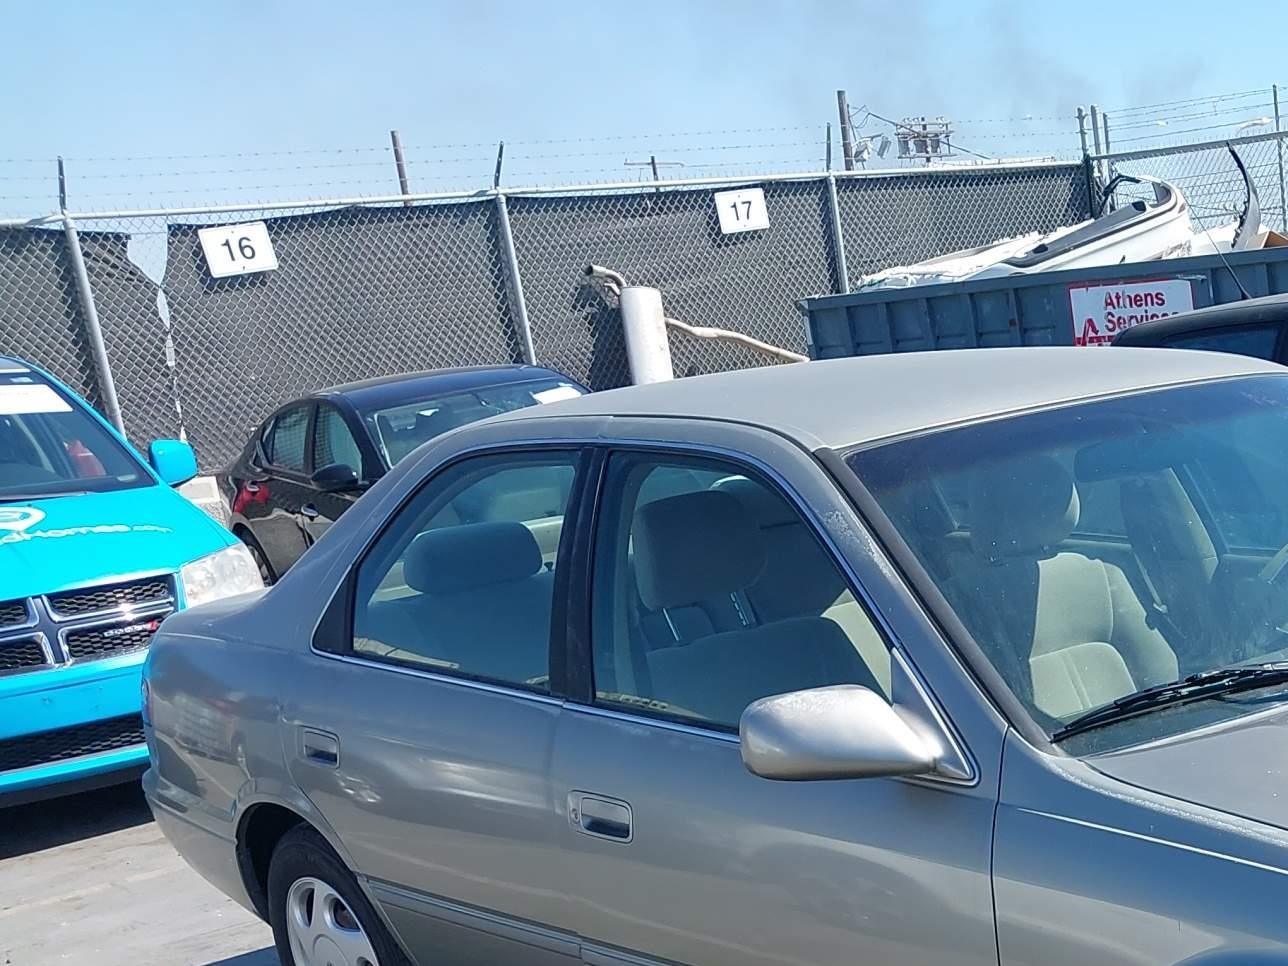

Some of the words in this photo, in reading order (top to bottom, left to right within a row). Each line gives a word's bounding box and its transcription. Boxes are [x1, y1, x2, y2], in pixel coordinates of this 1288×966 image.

[730, 201, 752, 221] 17
[221, 236, 256, 262] 16
[1104, 288, 1166, 310] Athens
